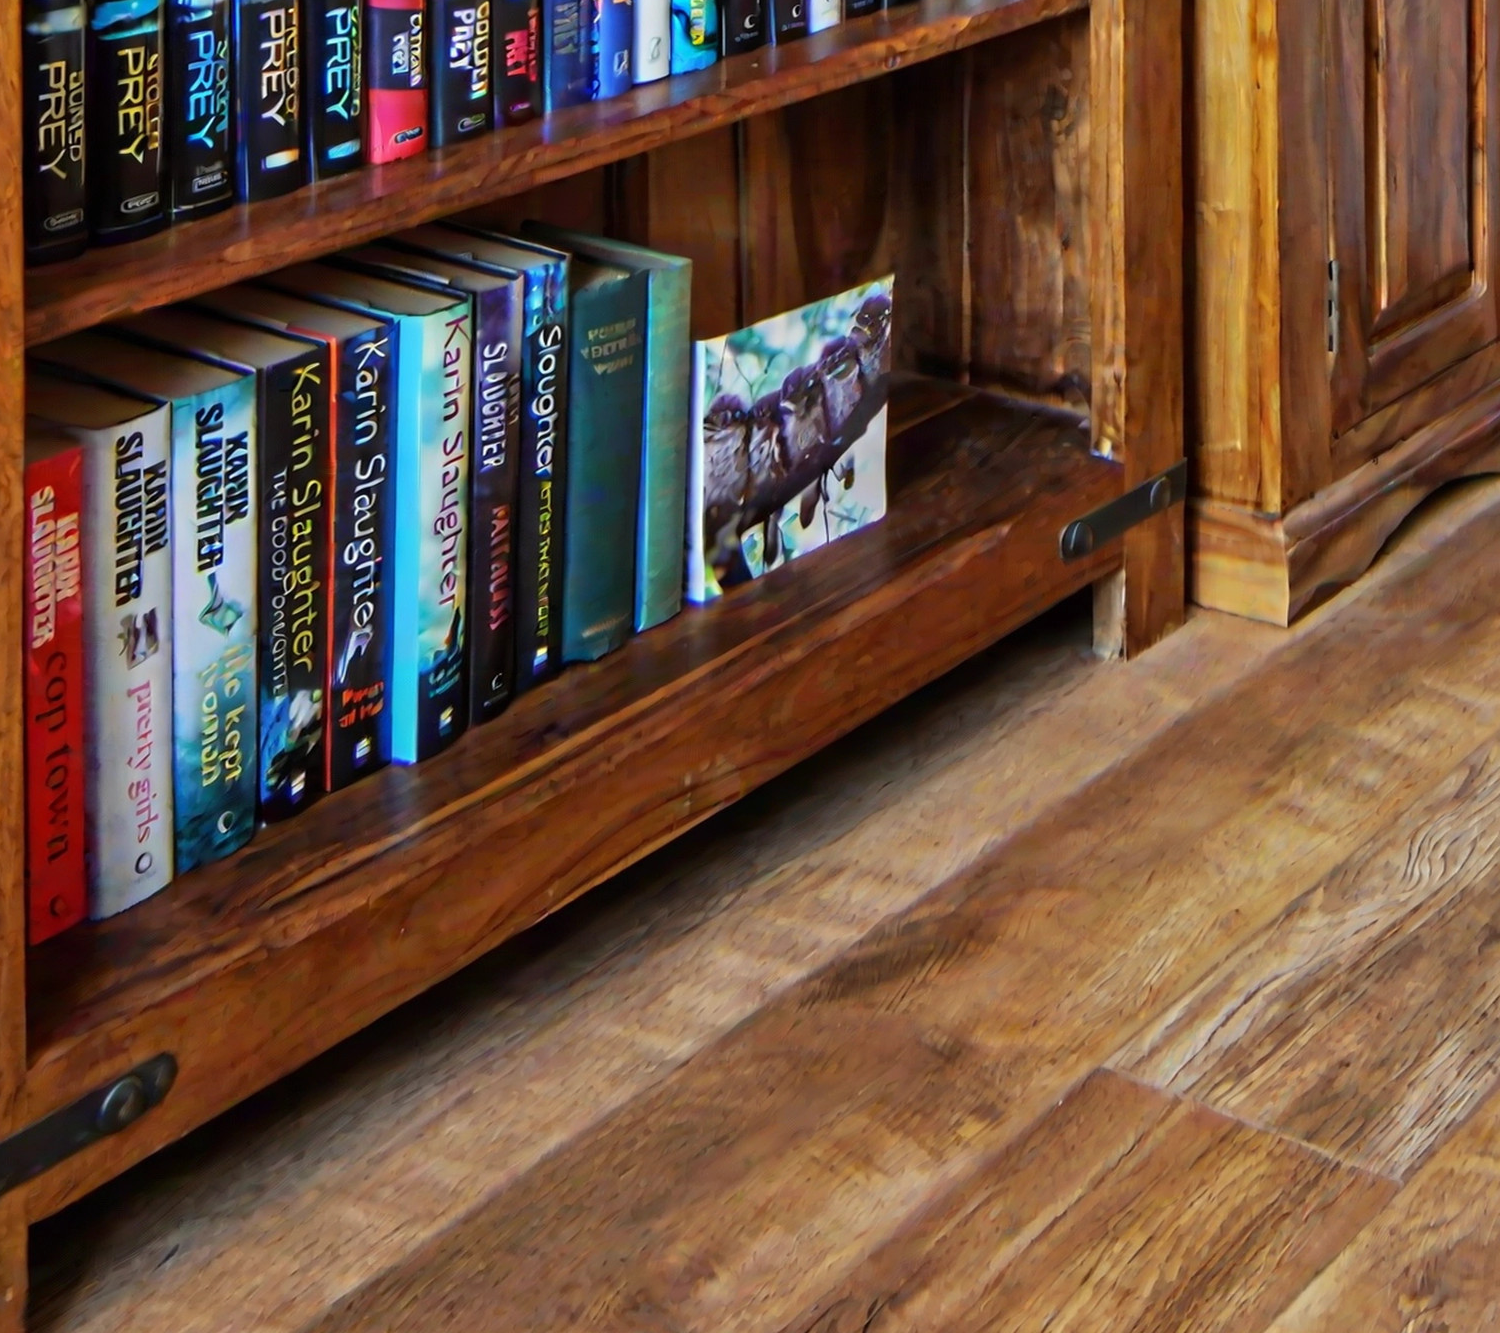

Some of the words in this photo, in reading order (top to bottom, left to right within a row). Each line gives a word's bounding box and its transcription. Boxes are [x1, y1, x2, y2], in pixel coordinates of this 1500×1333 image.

[37, 60, 67, 180] PREY
[117, 46, 147, 164] PREY
[187, 29, 215, 149] PREY
[260, 7, 287, 126] PREY
[325, 7, 351, 119] PREY
[291, 363, 321, 471] Karin
[355, 337, 388, 445] Karin
[444, 314, 468, 422] Karin
[531, 325, 562, 477] Slaughter
[114, 432, 143, 607] SLAUGHTER
[195, 402, 224, 574] SLAUGHTER
[434, 429, 461, 605] Slaughter
[285, 479, 321, 673] Slaughter
[343, 455, 387, 657] Slaughter
[36, 651, 67, 736] cop
[127, 681, 153, 770] pretty
[224, 705, 247, 781] kept
[45, 746, 68, 862] town
[128, 773, 153, 844] girls
